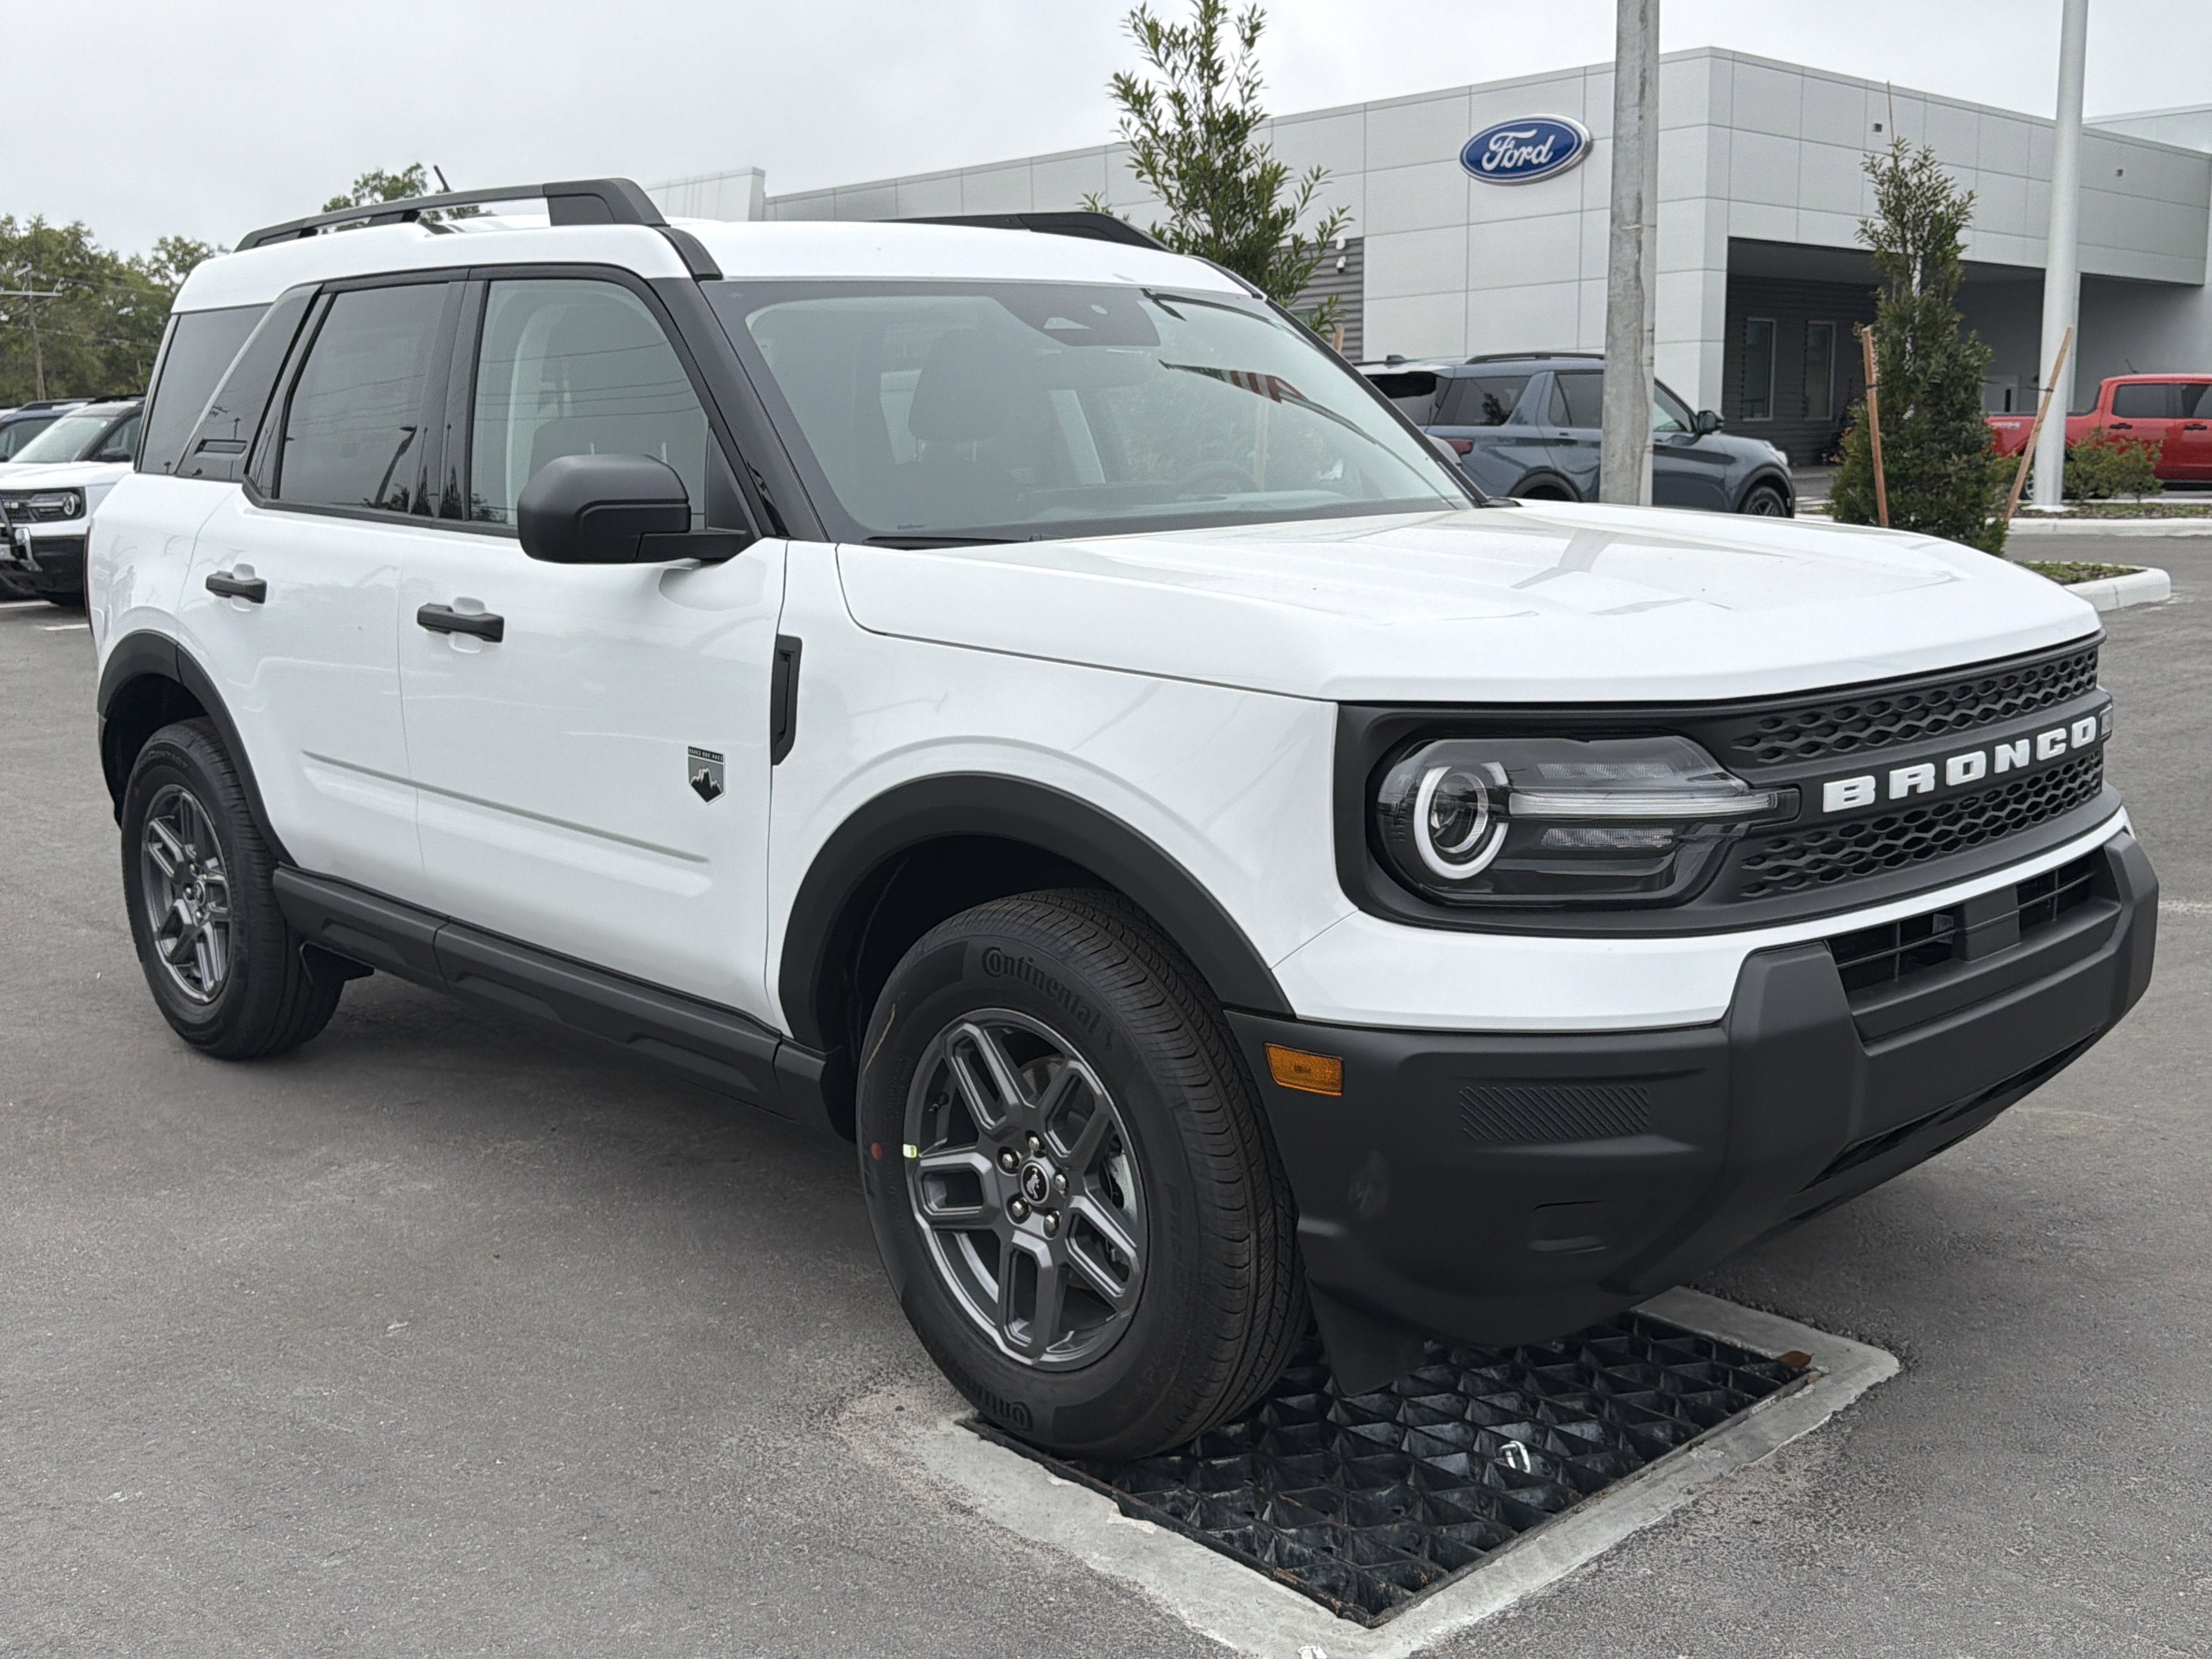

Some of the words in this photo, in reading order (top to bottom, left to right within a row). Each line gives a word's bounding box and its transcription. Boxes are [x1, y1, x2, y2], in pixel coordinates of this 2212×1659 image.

[1481, 129, 1555, 171] Ford
[1822, 716, 2096, 813] BRONCO
[981, 946, 1102, 1034] Continental
